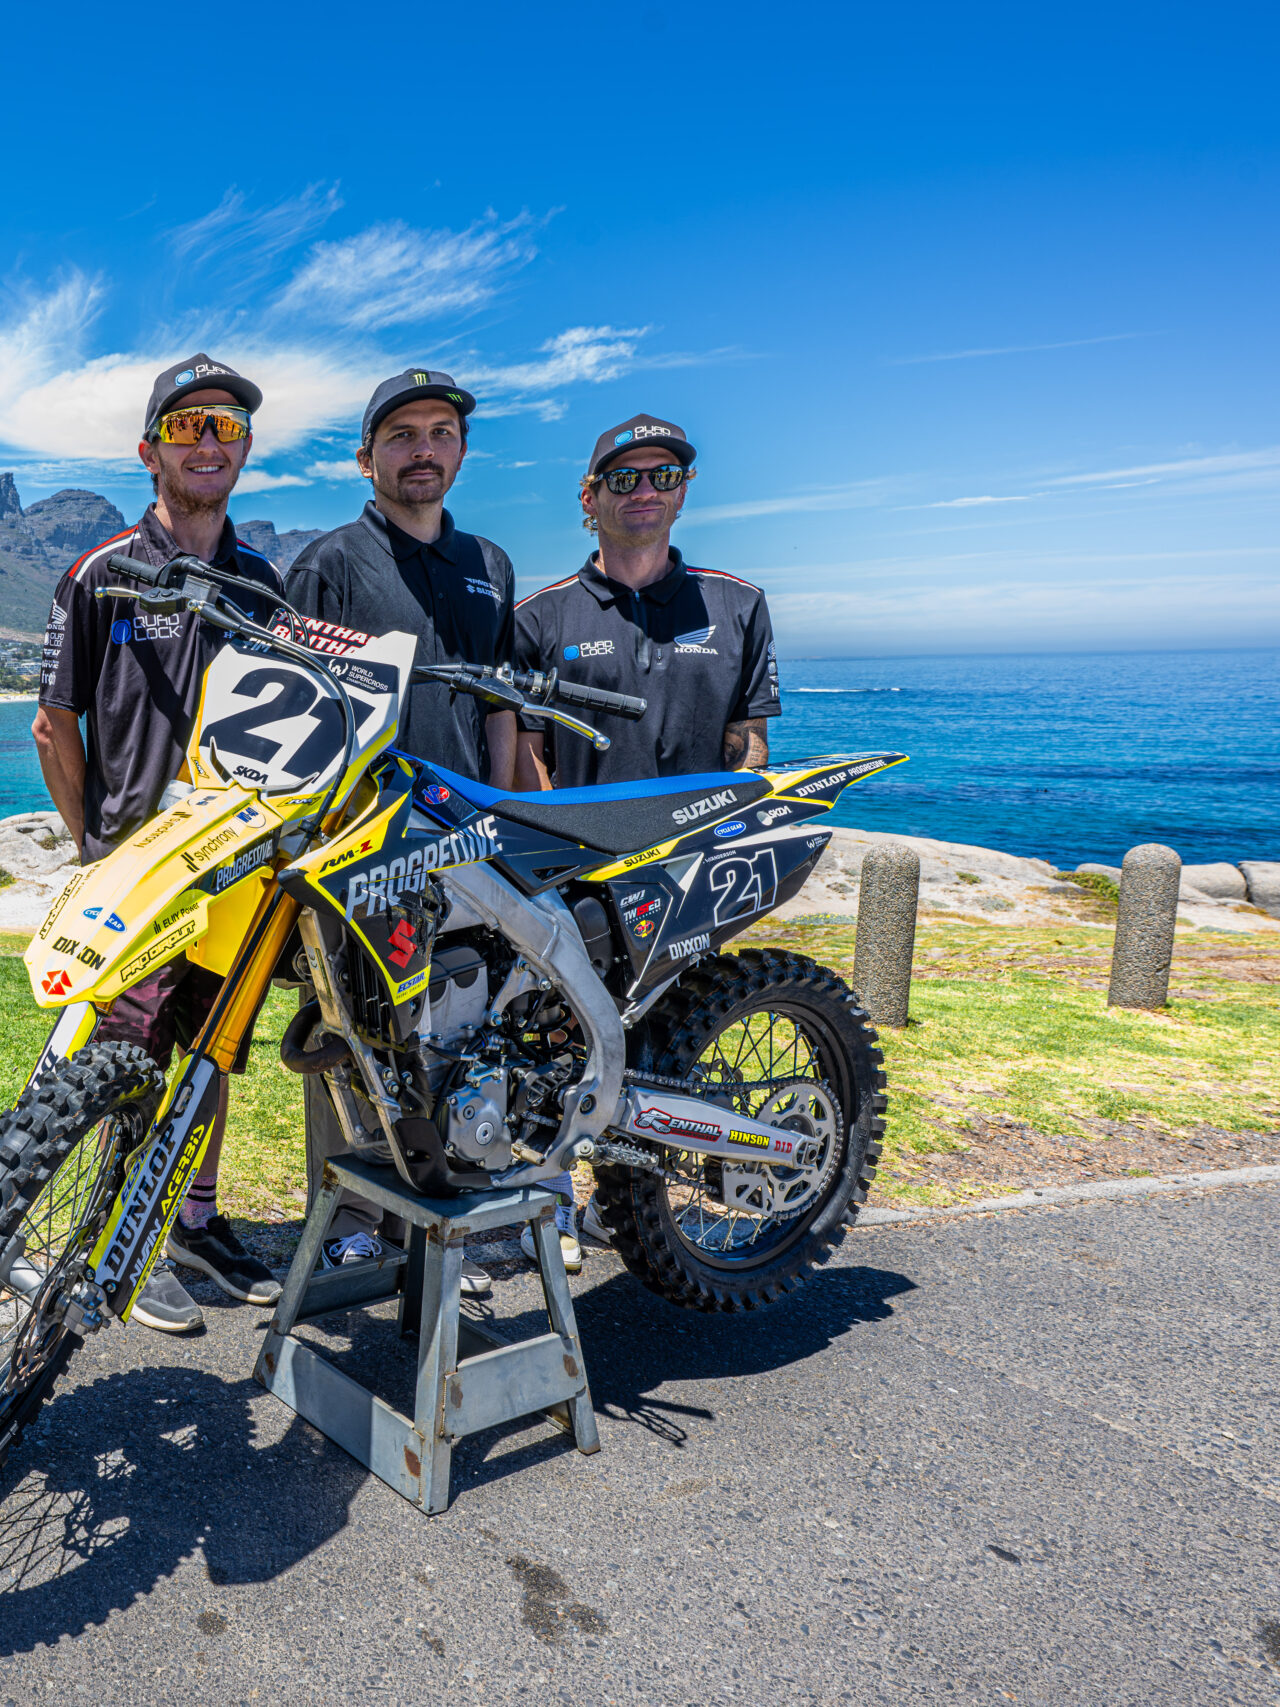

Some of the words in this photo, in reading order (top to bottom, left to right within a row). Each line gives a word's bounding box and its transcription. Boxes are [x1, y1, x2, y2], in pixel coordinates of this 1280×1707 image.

[634, 425, 671, 436] QUAD
[133, 613, 180, 628] QUAD
[277, 611, 378, 645] NTHA
[134, 626, 181, 641] LOCK
[580, 640, 613, 649] QUAD
[581, 647, 614, 657] LOCK
[674, 647, 718, 655] HONDA
[348, 671, 389, 691] SUPERCROSS
[351, 665, 374, 678] WORLD
[346, 676, 376, 691] CHAMPIONSHIP
[199, 668, 376, 784] 21
[233, 765, 269, 785] SKDA
[794, 771, 848, 797] DUNLOP
[847, 759, 888, 777] PROGRESSIVE
[671, 789, 738, 826] SUZUKI
[768, 805, 793, 820] SKDA
[195, 826, 239, 862] synchrony
[319, 839, 374, 874] RM-Z
[623, 848, 661, 868] SUZUKI
[345, 814, 503, 923] PROGRESSIVE
[709, 847, 779, 928] 21
[181, 902, 200, 917] Power
[120, 951, 151, 982] PRO
[147, 920, 196, 961] CIRCUIT
[668, 933, 710, 960] DIXXON
[397, 971, 425, 994] ECSTAR
[729, 1130, 770, 1147] HINSON
[105, 1122, 176, 1278] DUNLOP
[129, 1217, 163, 1288] NISSIN
